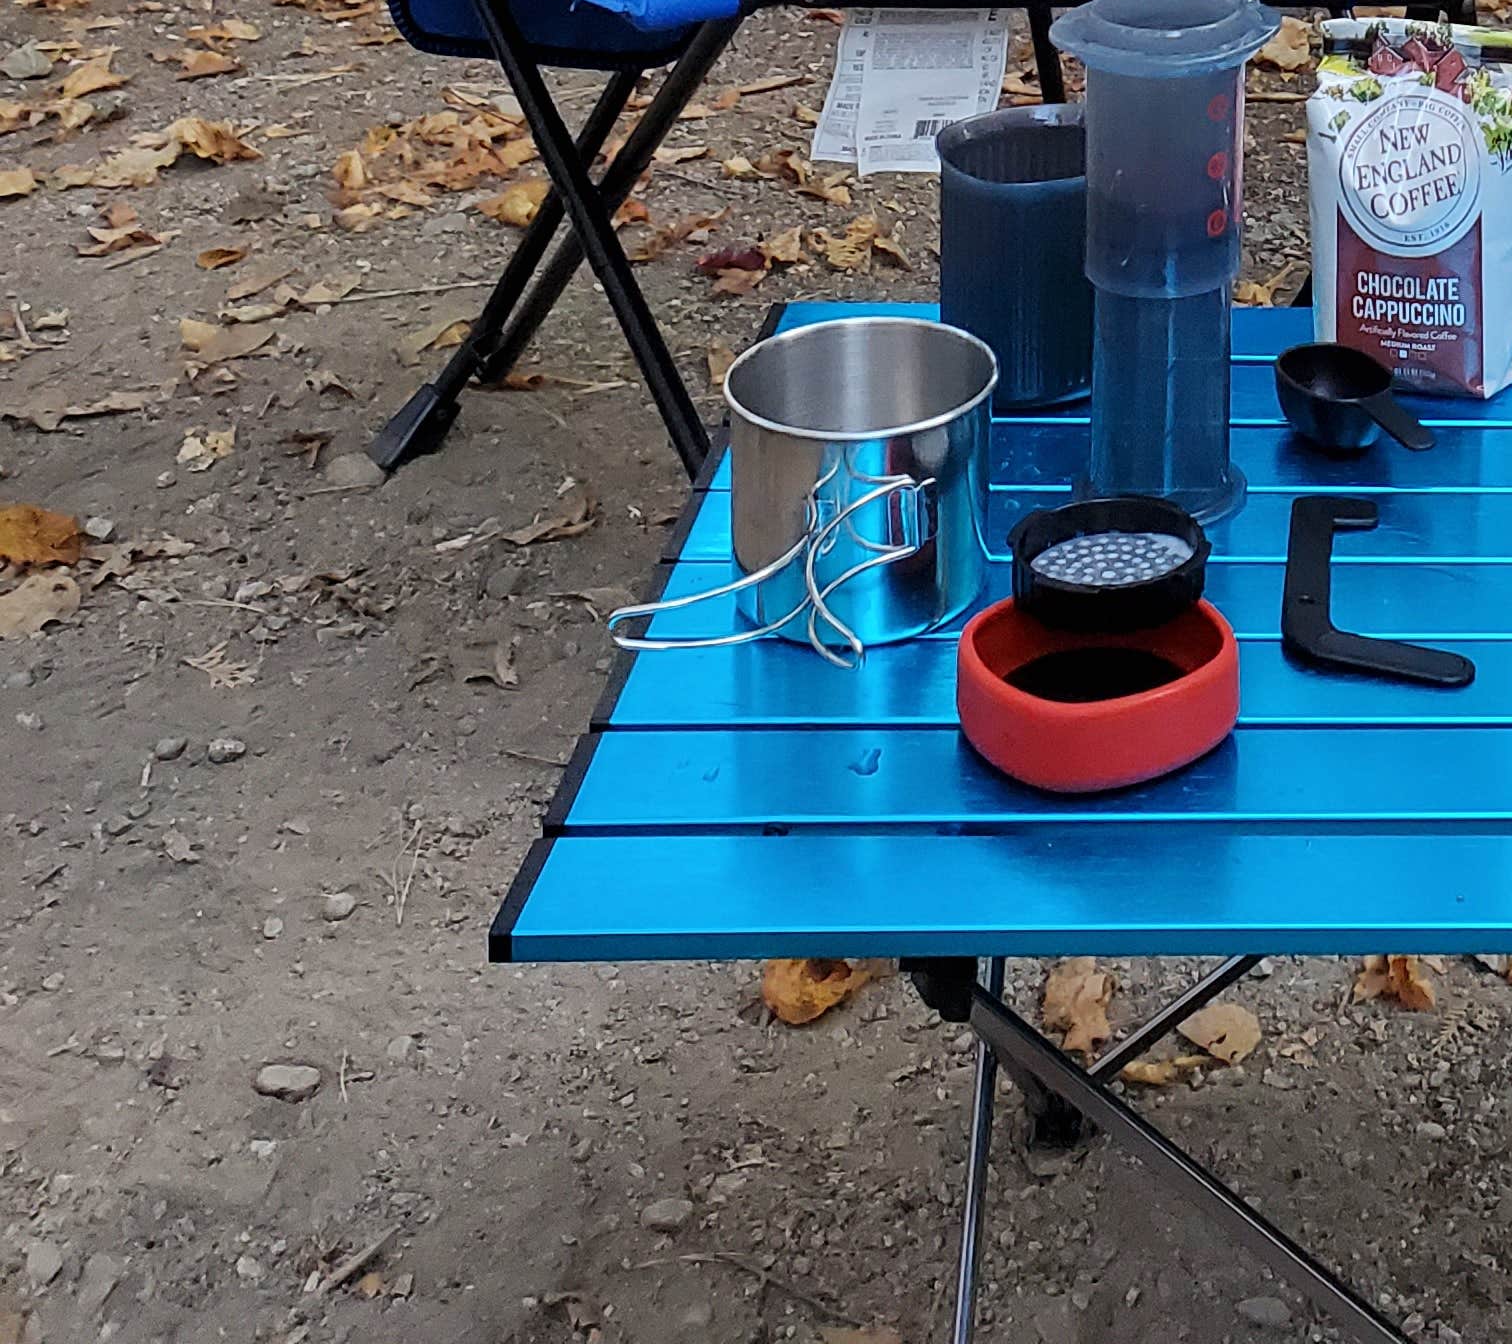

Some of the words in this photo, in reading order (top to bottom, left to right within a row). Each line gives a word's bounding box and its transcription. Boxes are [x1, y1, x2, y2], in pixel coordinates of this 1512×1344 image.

[1378, 123, 1431, 155] NEW
[1356, 143, 1462, 191] ENGLAND
[1370, 173, 1462, 219] COFFEE
[1357, 271, 1460, 301] CHOCOLATE
[1352, 295, 1466, 327] CAPPUCCINO
[1380, 339, 1411, 349] MEDIUM
[1397, 327, 1429, 340] Flavored
[1430, 330, 1458, 341] Coffee
